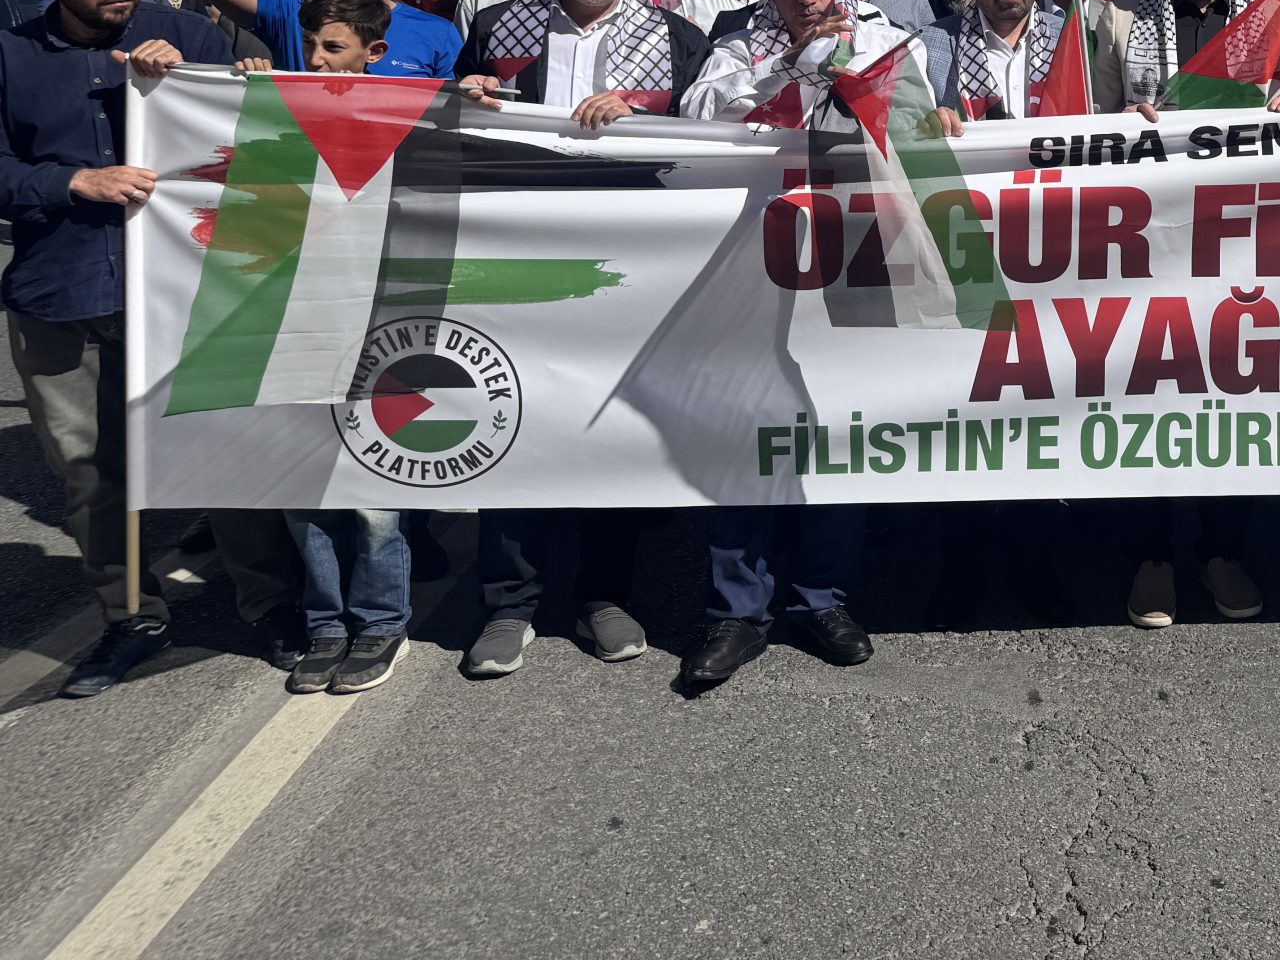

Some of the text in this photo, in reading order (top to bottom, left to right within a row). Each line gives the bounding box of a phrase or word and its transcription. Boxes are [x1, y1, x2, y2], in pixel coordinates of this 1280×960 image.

[1029, 130, 1168, 168] SIRA
[762, 169, 1153, 291] ÖZGÜR
[445, 329, 512, 401] DESTEK
[361, 439, 495, 481] PLATFORMU
[757, 408, 1060, 476] FİLİSTİN'E
